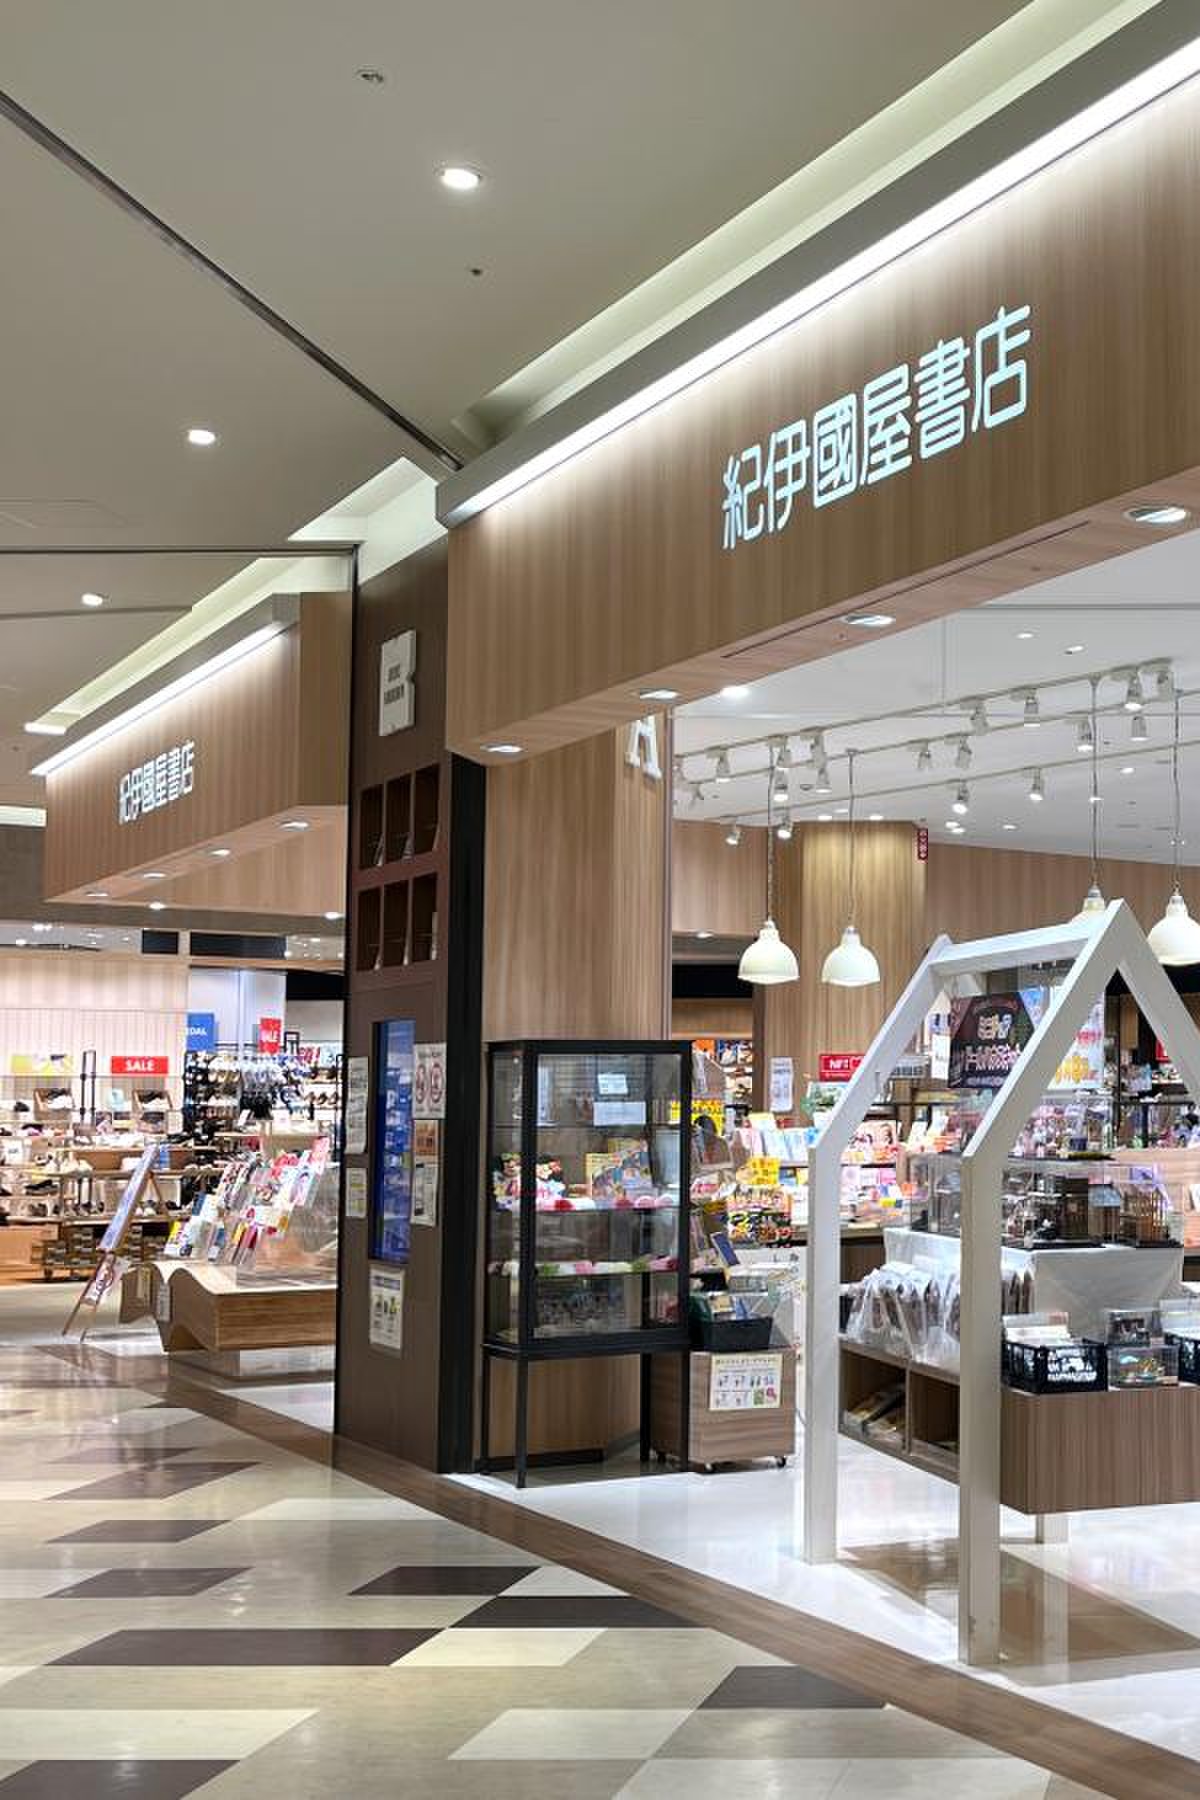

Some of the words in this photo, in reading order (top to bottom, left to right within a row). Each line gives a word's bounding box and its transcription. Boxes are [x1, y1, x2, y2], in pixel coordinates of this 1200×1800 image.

[722, 304, 1031, 550] 紀伊國屋書店
[118, 740, 195, 825] 紀伊國屋書店
[124, 1059, 156, 1072] SALE
